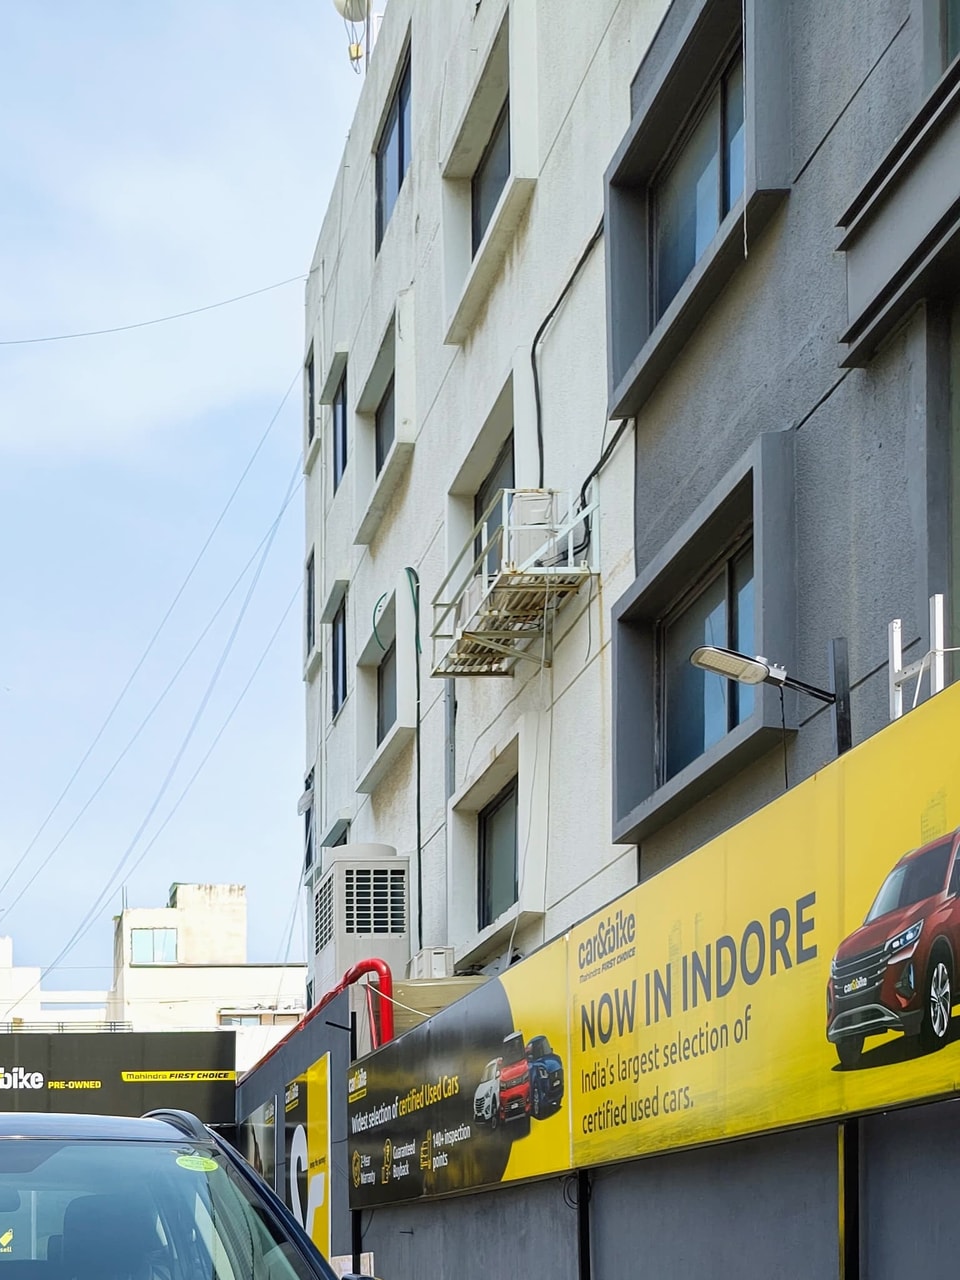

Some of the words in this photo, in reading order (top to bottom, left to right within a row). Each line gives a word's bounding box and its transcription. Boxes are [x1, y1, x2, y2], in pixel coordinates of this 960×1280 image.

[578, 909, 635, 970] car&bike
[581, 979, 637, 1052] NOW
[645, 963, 672, 1026] IN
[682, 891, 817, 1012] INDORE
[581, 1058, 615, 1094] India's
[617, 1043, 660, 1084] largest
[663, 1021, 728, 1068] selection
[734, 1004, 752, 1044] of
[48, 1080, 102, 1089] PRE-OWNED
[351, 1110, 368, 1135] Widest
[368, 1102, 391, 1129] selection
[392, 1096, 399, 1119] of
[399, 1085, 424, 1116] certified
[425, 1076, 442, 1106] Used
[443, 1075, 459, 1099] Cars
[582, 1095, 627, 1135] certified
[631, 1085, 659, 1121] used
[663, 1085, 694, 1114] cars.
[432, 1151, 448, 1172] points
[444, 1123, 471, 1147] inspection
